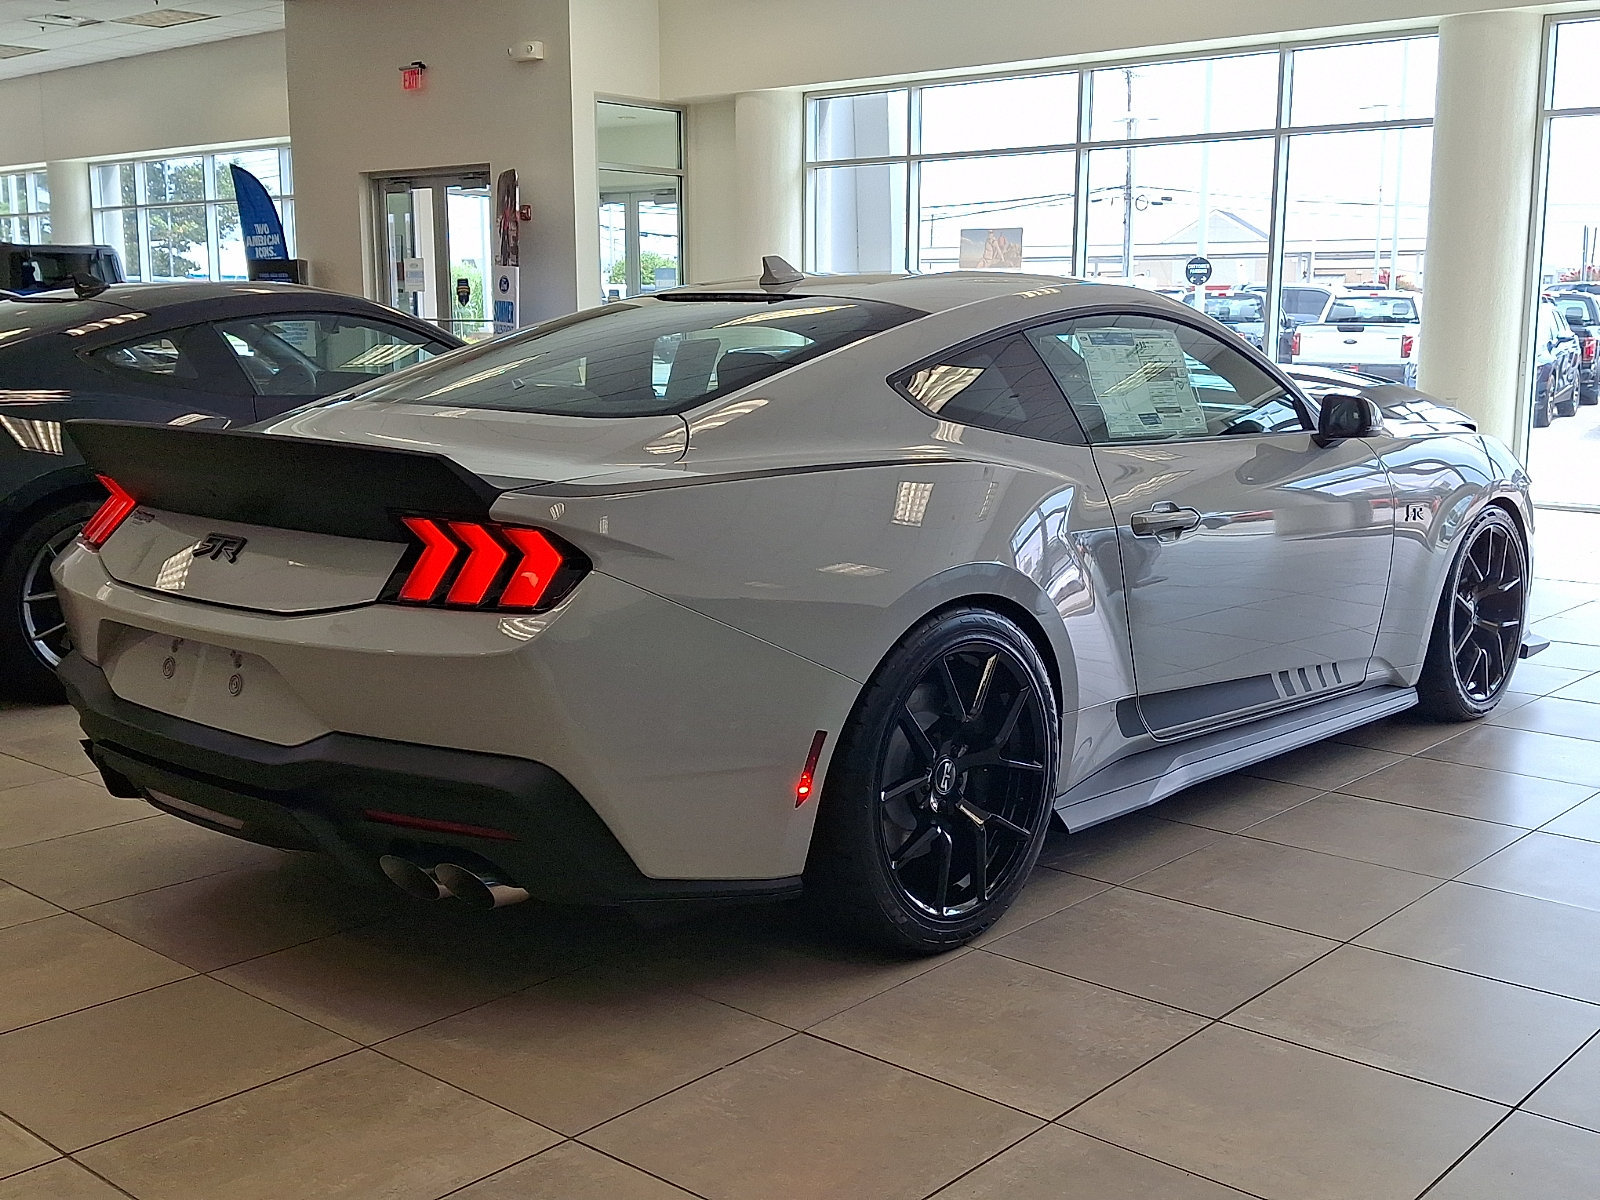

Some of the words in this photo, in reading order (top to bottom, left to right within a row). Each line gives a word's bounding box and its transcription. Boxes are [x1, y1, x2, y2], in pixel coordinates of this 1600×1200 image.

[403, 70, 419, 89] EXIT
[254, 223, 270, 235] TWO
[246, 233, 281, 247] AMERICAN
